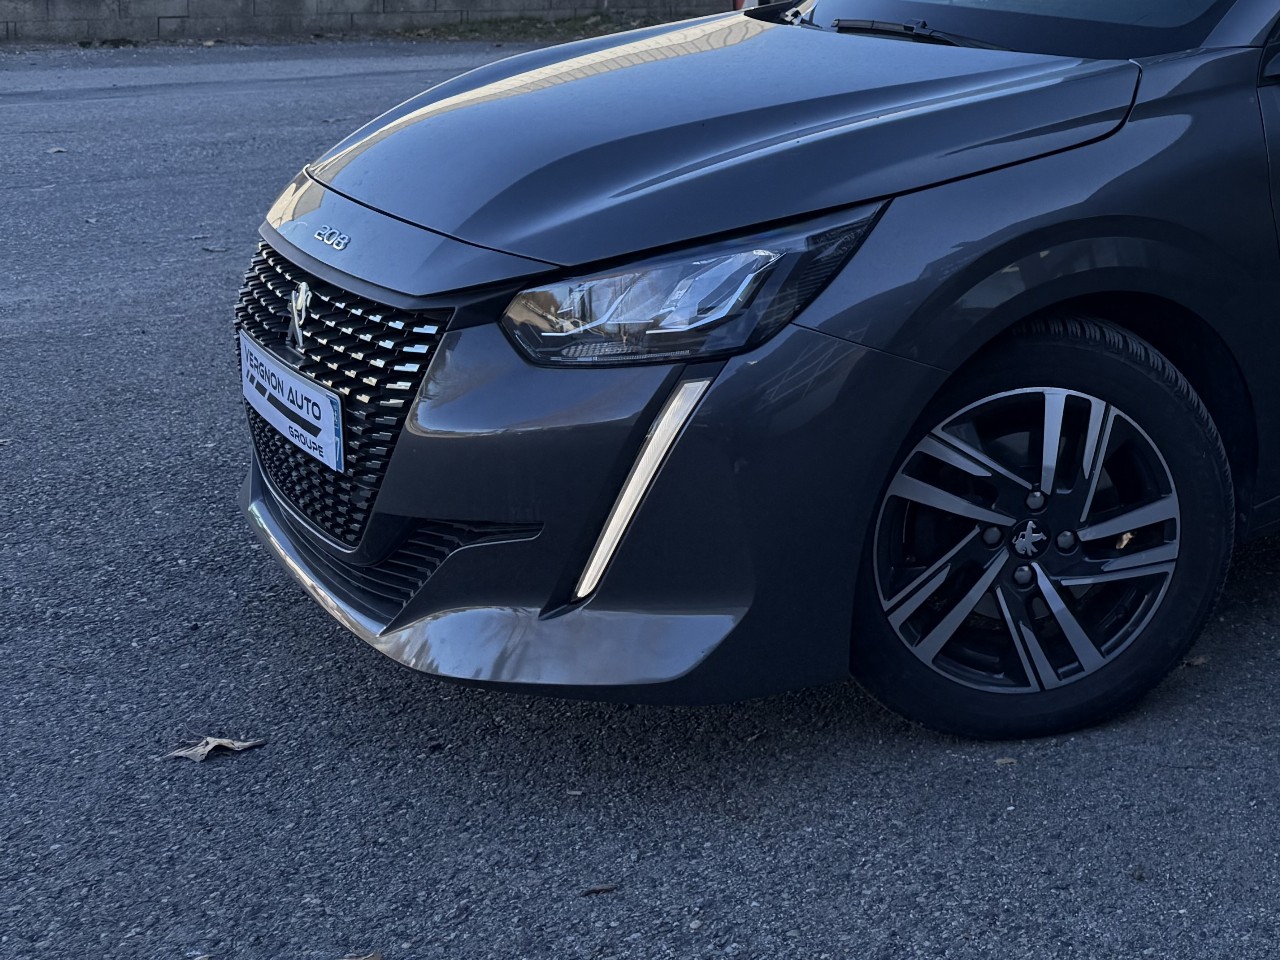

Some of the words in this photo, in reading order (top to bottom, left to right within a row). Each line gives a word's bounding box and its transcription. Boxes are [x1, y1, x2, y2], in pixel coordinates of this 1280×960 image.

[314, 224, 351, 250] 208
[244, 344, 285, 397] VERGNON
[287, 386, 322, 421] AUTO
[288, 425, 325, 458] GROUPE
